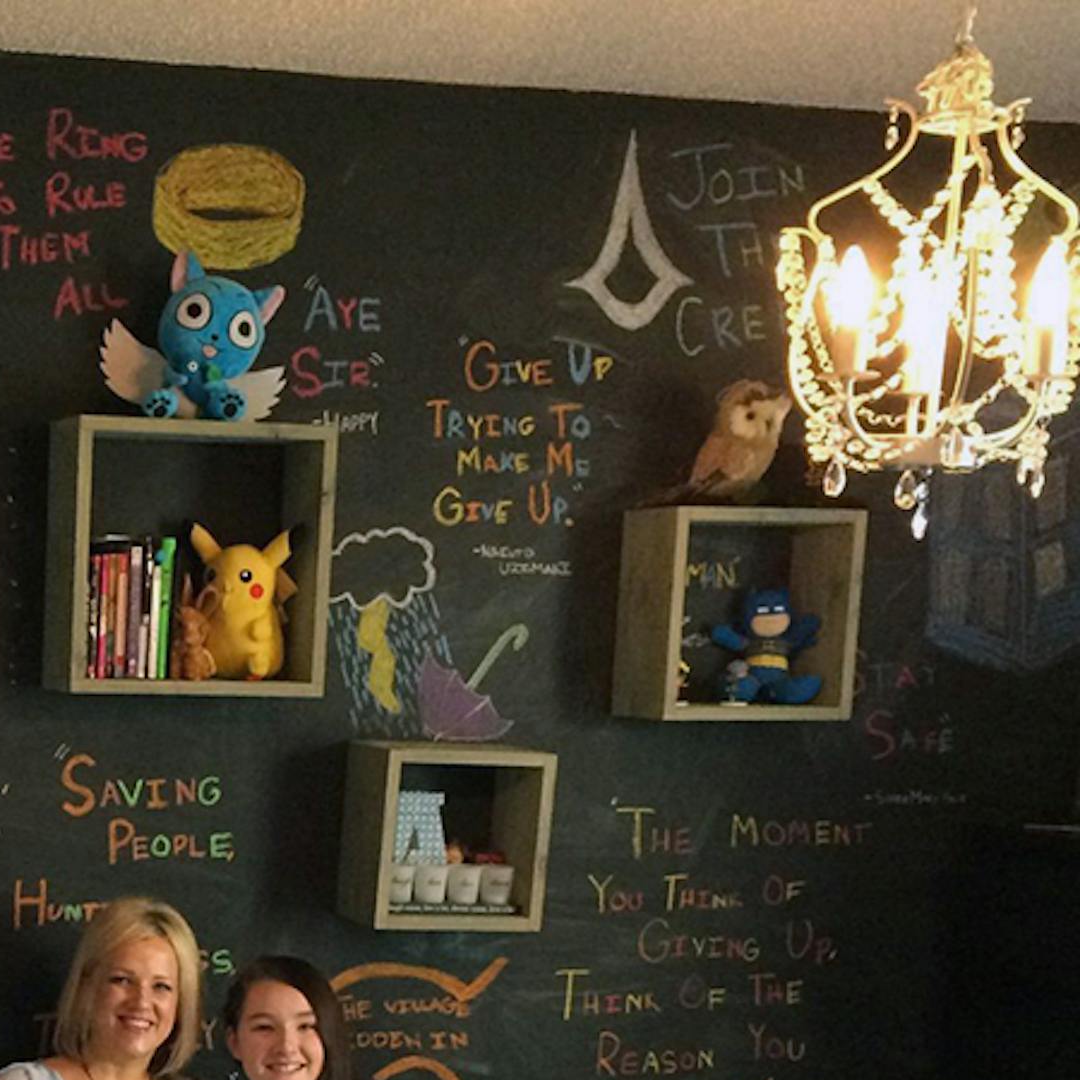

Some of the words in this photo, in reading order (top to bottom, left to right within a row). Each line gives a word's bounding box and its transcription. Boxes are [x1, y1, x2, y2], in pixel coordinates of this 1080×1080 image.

[46, 107, 148, 163] RING
[46, 171, 127, 217] RULE
[666, 143, 806, 210] JOIN
[695, 222, 764, 277] TH
[55, 277, 130, 318] ALL
[676, 296, 767, 357] CRE
[568, 342, 614, 386] UP
[426, 399, 535, 439] TRYING
[548, 402, 591, 439] TO
[456, 446, 531, 477] MAKE
[546, 441, 590, 478] ME
[433, 485, 513, 526] GIVE
[730, 813, 872, 848] MOMENT
[587, 873, 644, 914] YOU
[664, 873, 744, 912] THINK
[763, 874, 806, 906] OF
[637, 916, 760, 964] GIVING
[555, 968, 662, 1021] THINK
[679, 972, 727, 1011] OF
[747, 972, 805, 1007] THE
[430, 1031, 470, 1051] IN
[595, 1030, 715, 1078] REASON
[748, 1023, 806, 1061] YOU
